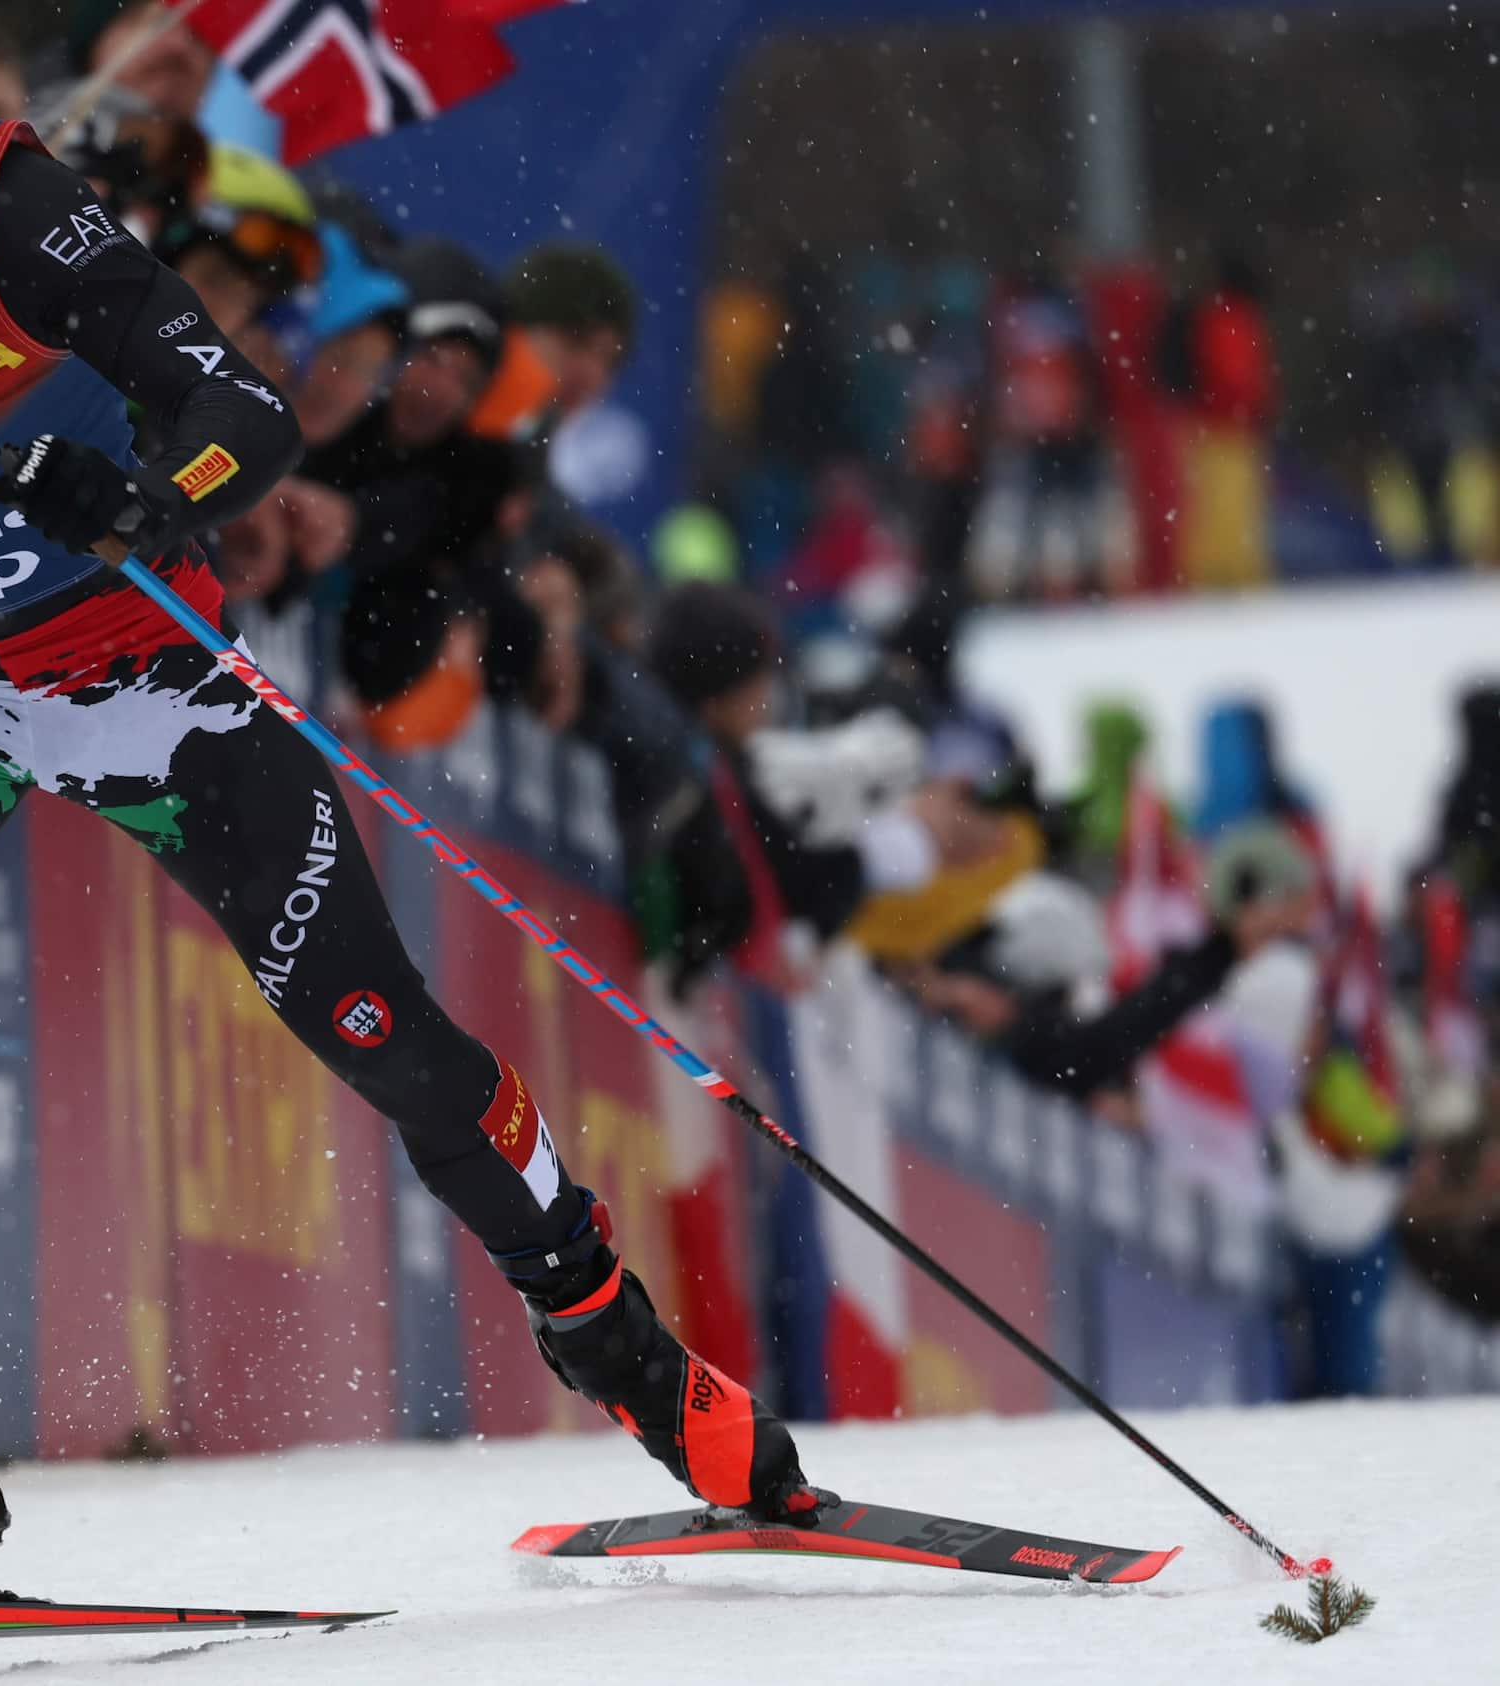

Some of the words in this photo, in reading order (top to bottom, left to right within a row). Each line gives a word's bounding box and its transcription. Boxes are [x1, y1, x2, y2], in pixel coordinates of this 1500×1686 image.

[254, 788, 338, 1009] FALCONERI
[340, 1000, 376, 1032] RTL
[354, 1009, 385, 1039] 102.5
